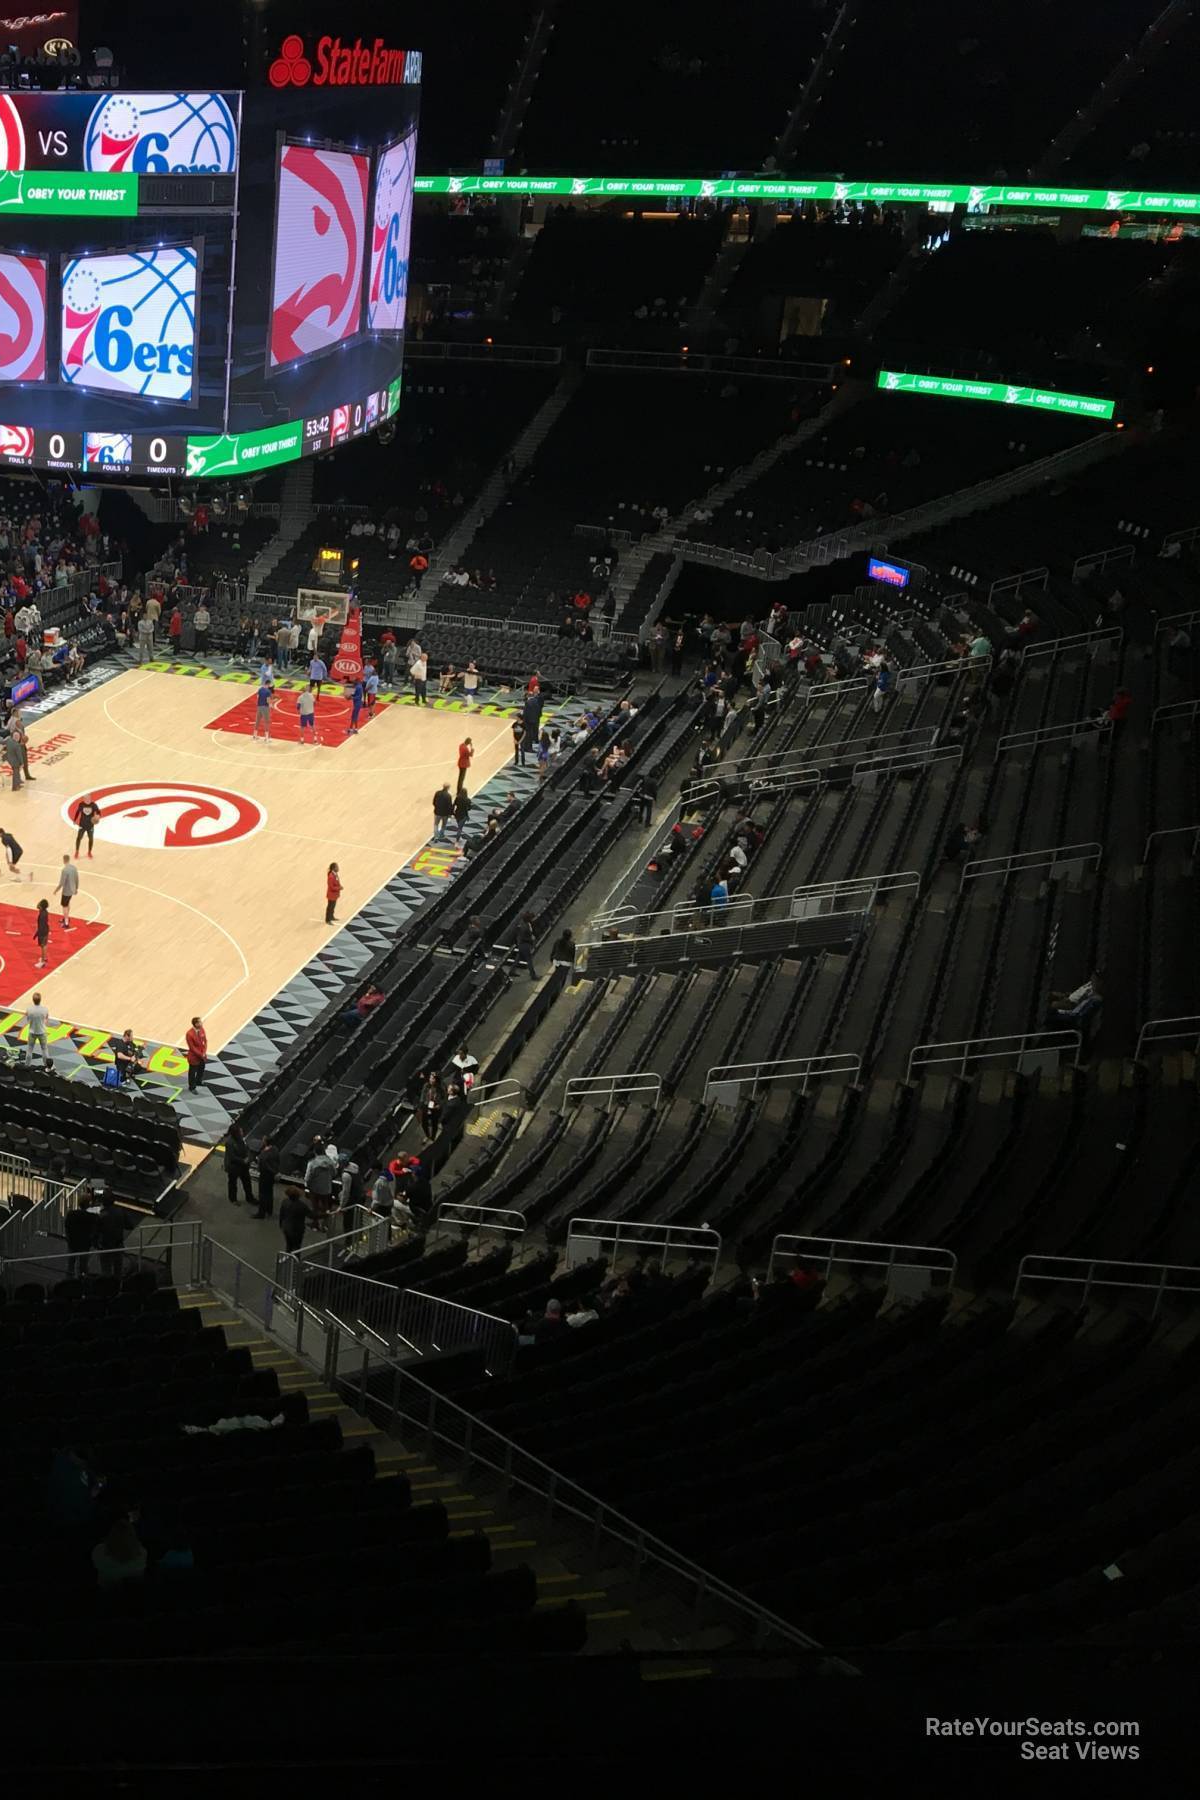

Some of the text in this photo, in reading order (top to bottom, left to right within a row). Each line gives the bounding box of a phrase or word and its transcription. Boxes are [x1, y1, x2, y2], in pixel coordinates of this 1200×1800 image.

[38, 131, 68, 156] VS
[482, 180, 557, 189] OBEY YOUR THIRST
[606, 182, 684, 192] OBEY YOUR THIRST
[737, 184, 817, 194] OBEY YOUR THIRST
[27, 187, 127, 201] OBEY YOUR THIRST
[871, 187, 953, 198] OBEY YOUR THIRST
[1006, 191, 1089, 203] OBEY YOUR THIRST
[1144, 197, 1197, 208] OBEY YOUR
[65, 304, 193, 376] 76ers
[918, 380, 992, 395] OBEY YOUR THIRST
[1036, 394, 1107, 412] OBEY YOUR THIRST
[354, 404, 362, 427] 0
[306, 416, 330, 438] 53:42
[49, 434, 66, 459] 0
[149, 437, 168, 463] 0
[241, 436, 298, 459] OBEY YOUR THIRST
[312, 439, 323, 451] 1ST
[102, 464, 122, 473] FOULS
[146, 466, 177, 475] TIMEOUTS
[339, 661, 358, 671] KIA
